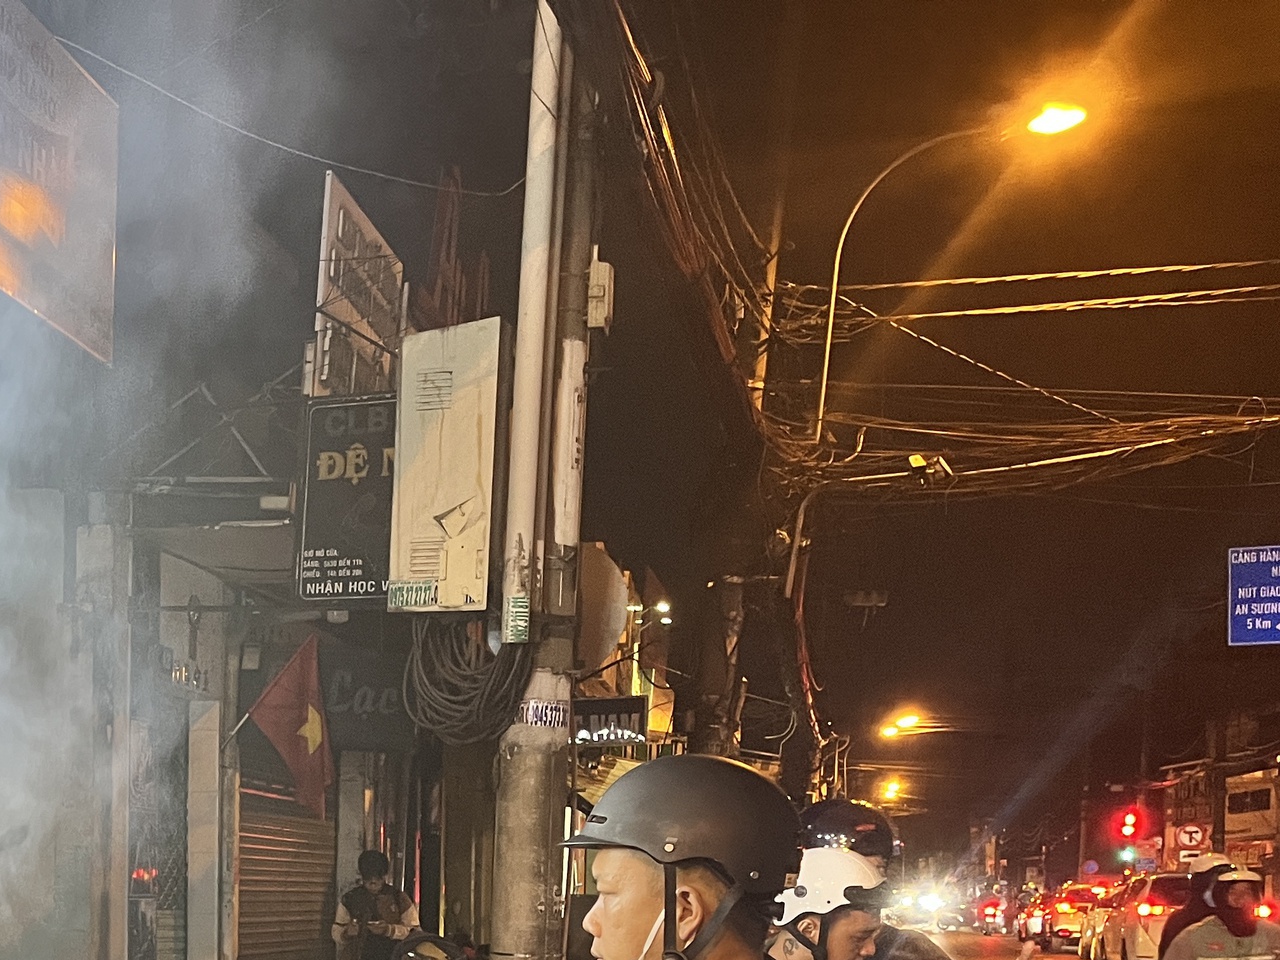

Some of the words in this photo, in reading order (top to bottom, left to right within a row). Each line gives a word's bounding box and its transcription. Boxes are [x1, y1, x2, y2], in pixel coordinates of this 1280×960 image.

[316, 442, 370, 486] ĐỆ
[1260, 547, 1280, 563] HÀN
[306, 579, 343, 597] NHẬN
[348, 580, 376, 595] HỌC
[1238, 583, 1258, 599] NÚT
[1235, 603, 1249, 615] AN
[1251, 602, 1280, 615] SƯƠN
[1246, 618, 1253, 630] 5
[1256, 617, 1272, 629] Km
